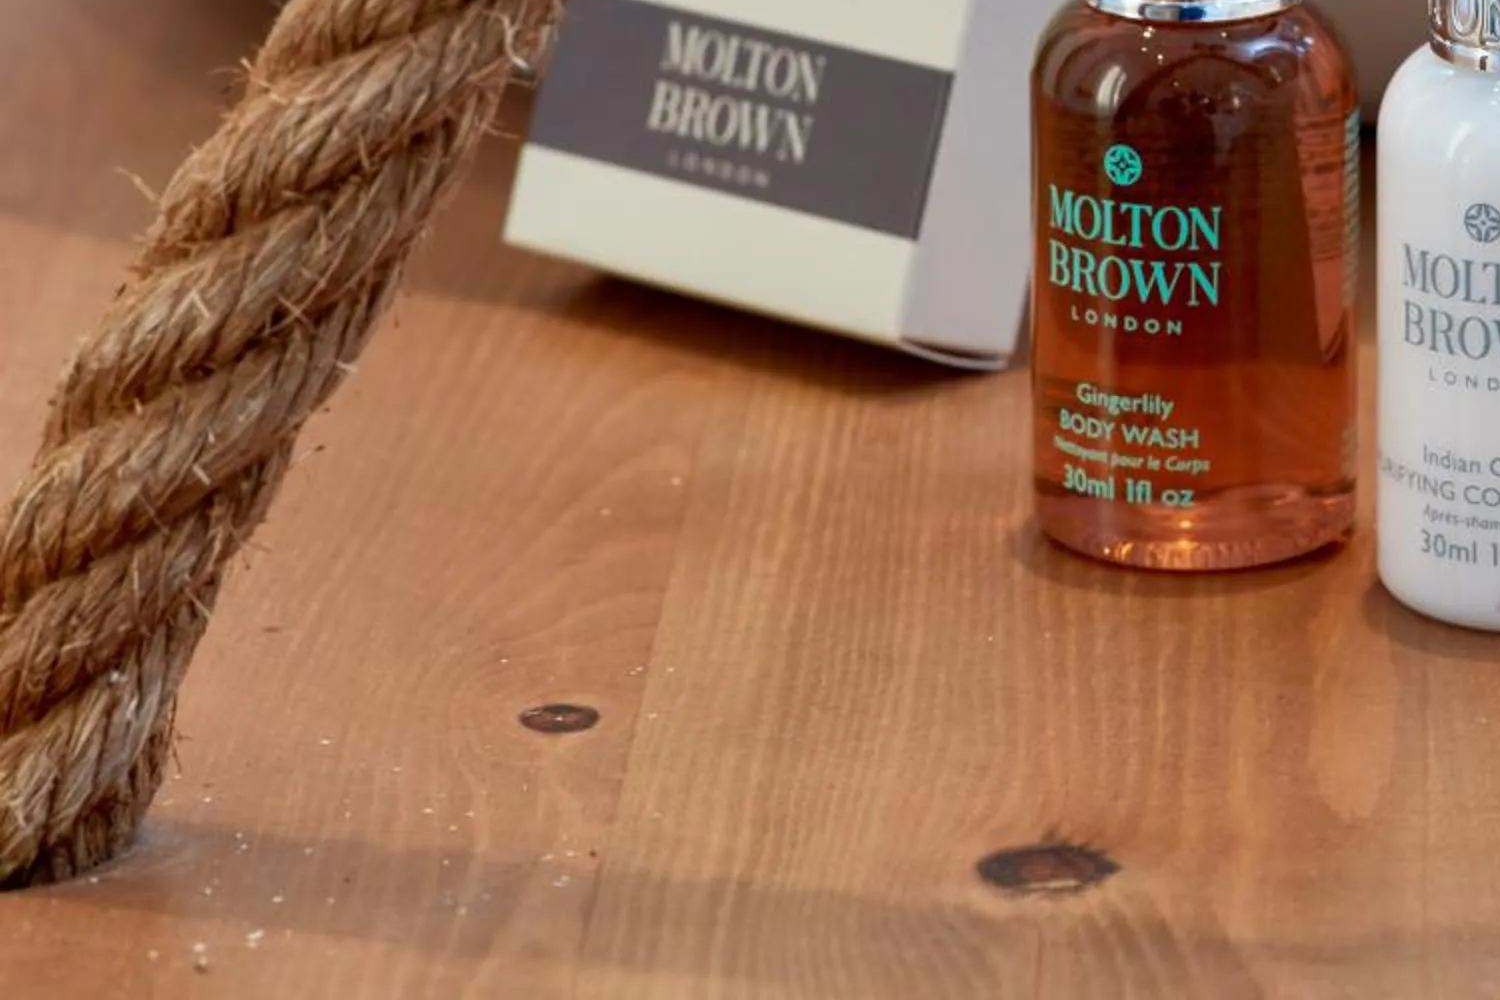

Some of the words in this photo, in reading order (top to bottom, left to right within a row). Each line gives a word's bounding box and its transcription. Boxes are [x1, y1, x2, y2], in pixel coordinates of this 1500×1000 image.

[659, 20, 827, 104] MOLTON
[647, 79, 814, 165] BROWN
[1049, 183, 1222, 251] MOLTON
[1049, 238, 1222, 307] BROWN
[1071, 305, 1183, 337] LONDON
[1075, 382, 1175, 421] Gingerlily
[1059, 407, 1116, 442] BODY
[1121, 423, 1200, 449] WASH
[1110, 451, 1144, 469] pour
[1164, 455, 1211, 476] Corps
[1422, 443, 1482, 475] Indian
[1062, 462, 1115, 501] 30ml
[1161, 488, 1196, 508] oz
[1420, 527, 1478, 565] 30ml
